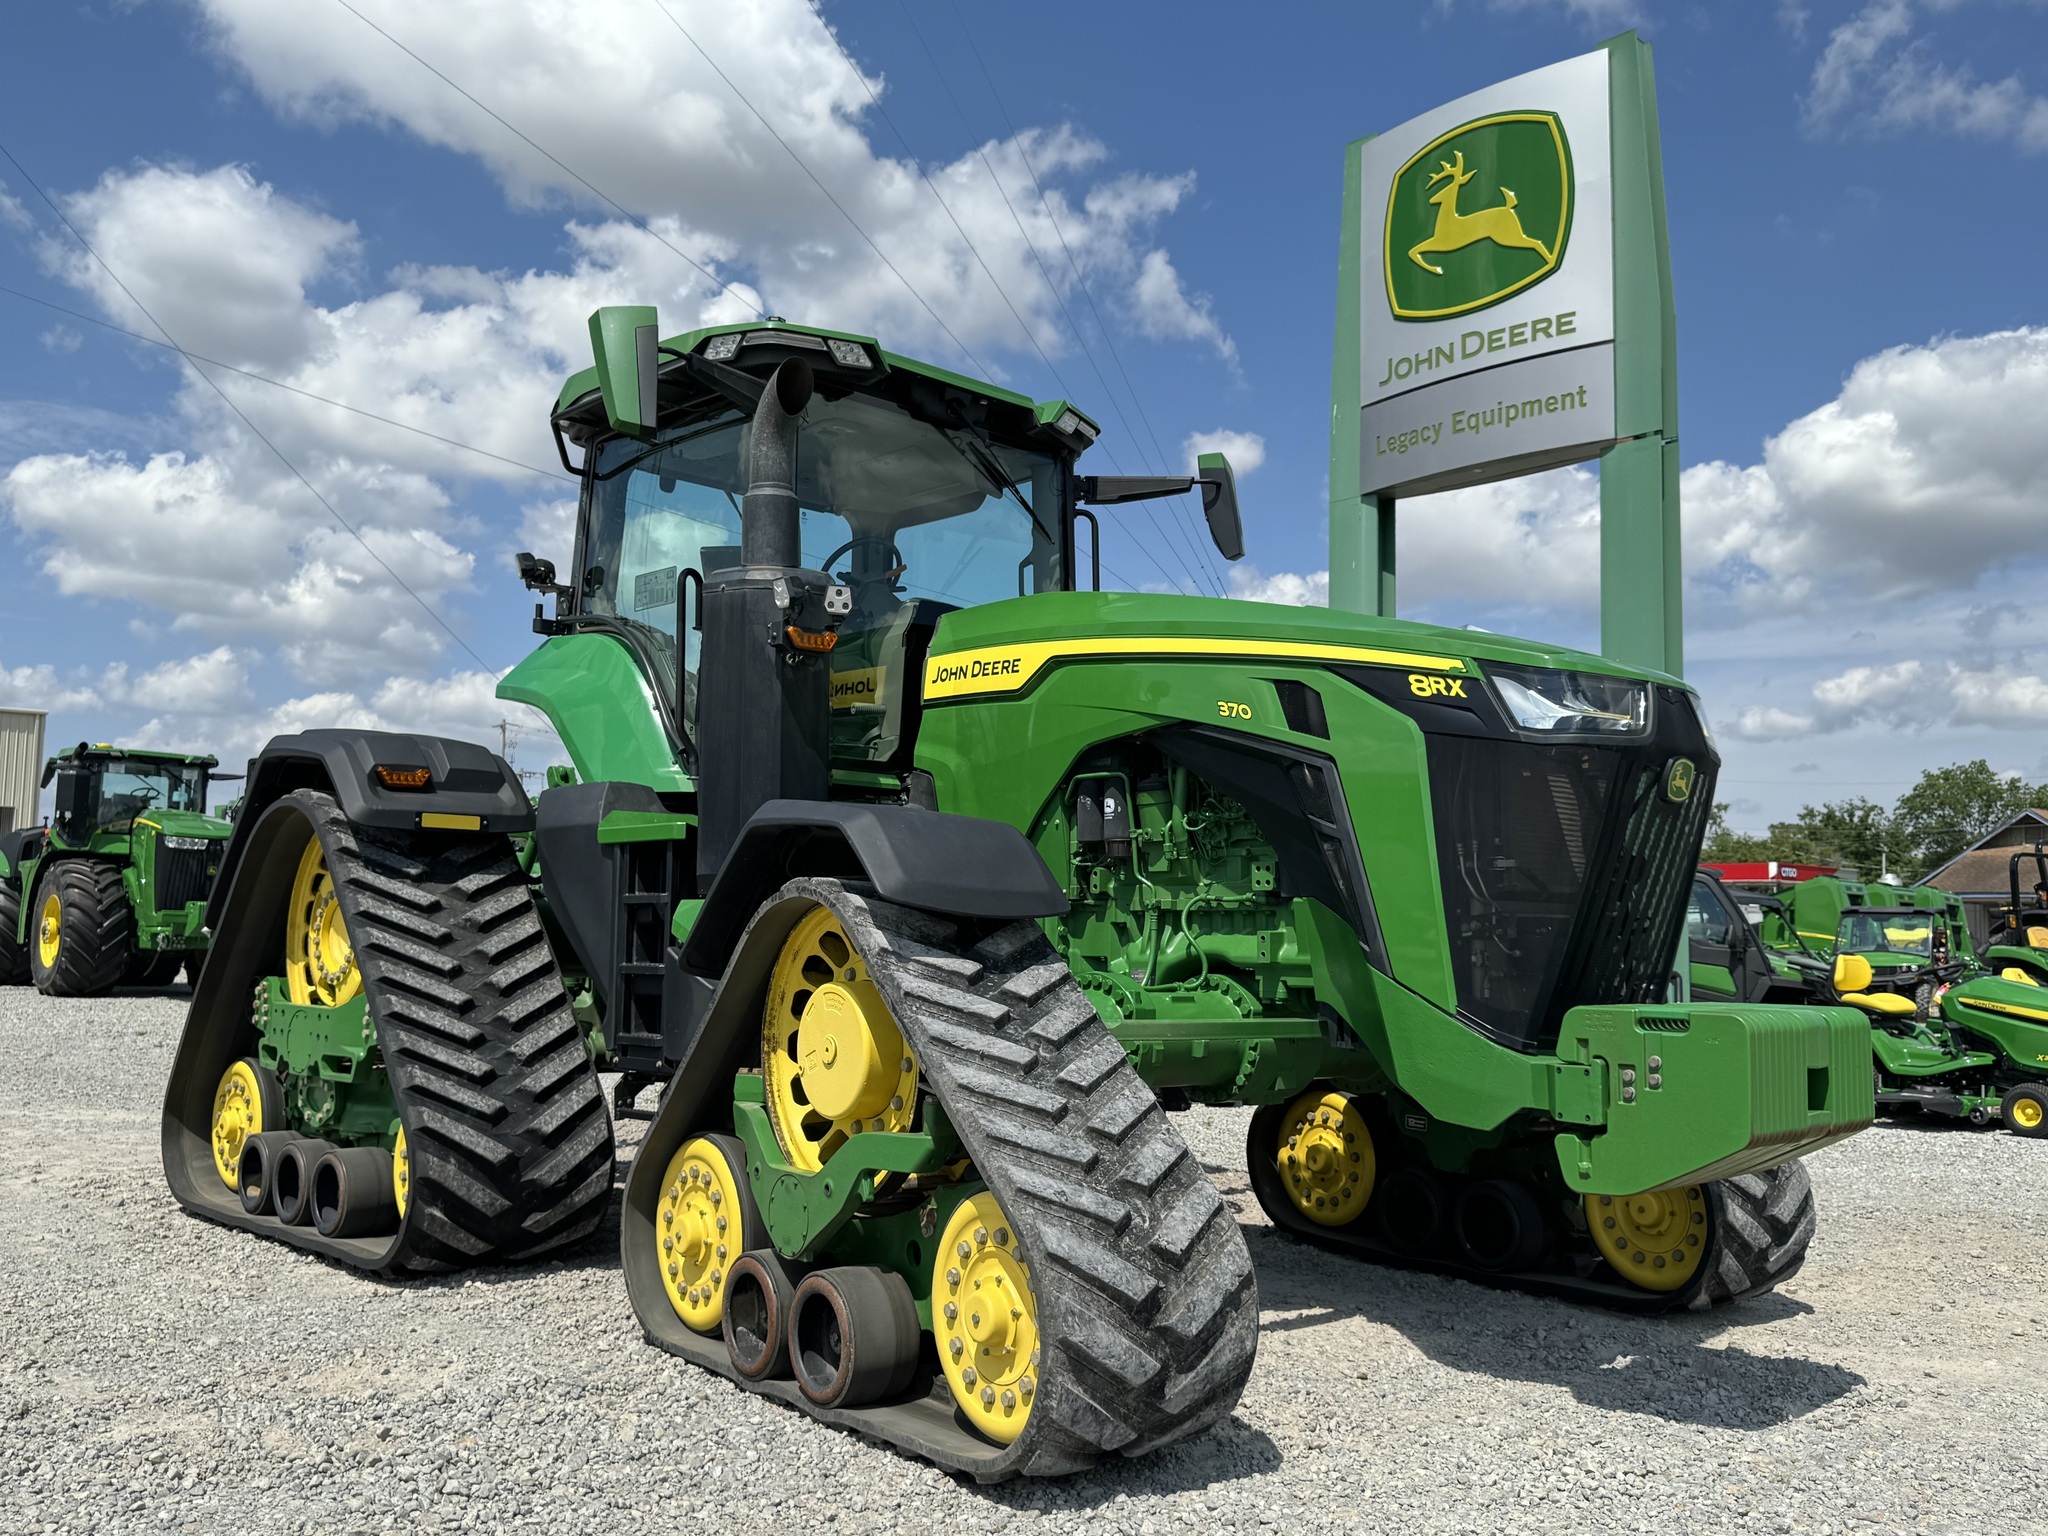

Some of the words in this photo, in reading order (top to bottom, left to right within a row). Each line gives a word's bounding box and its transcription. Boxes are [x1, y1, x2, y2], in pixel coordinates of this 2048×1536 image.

[1379, 342, 1454, 387] JOHN
[1461, 311, 1577, 360] DEERE
[1376, 422, 1443, 456] Legacy
[1451, 385, 1588, 435] Equipment
[931, 664, 969, 684] JOHN
[971, 658, 1021, 678] DEERE
[1408, 674, 1468, 699] 8RX
[1217, 701, 1252, 720] 370
